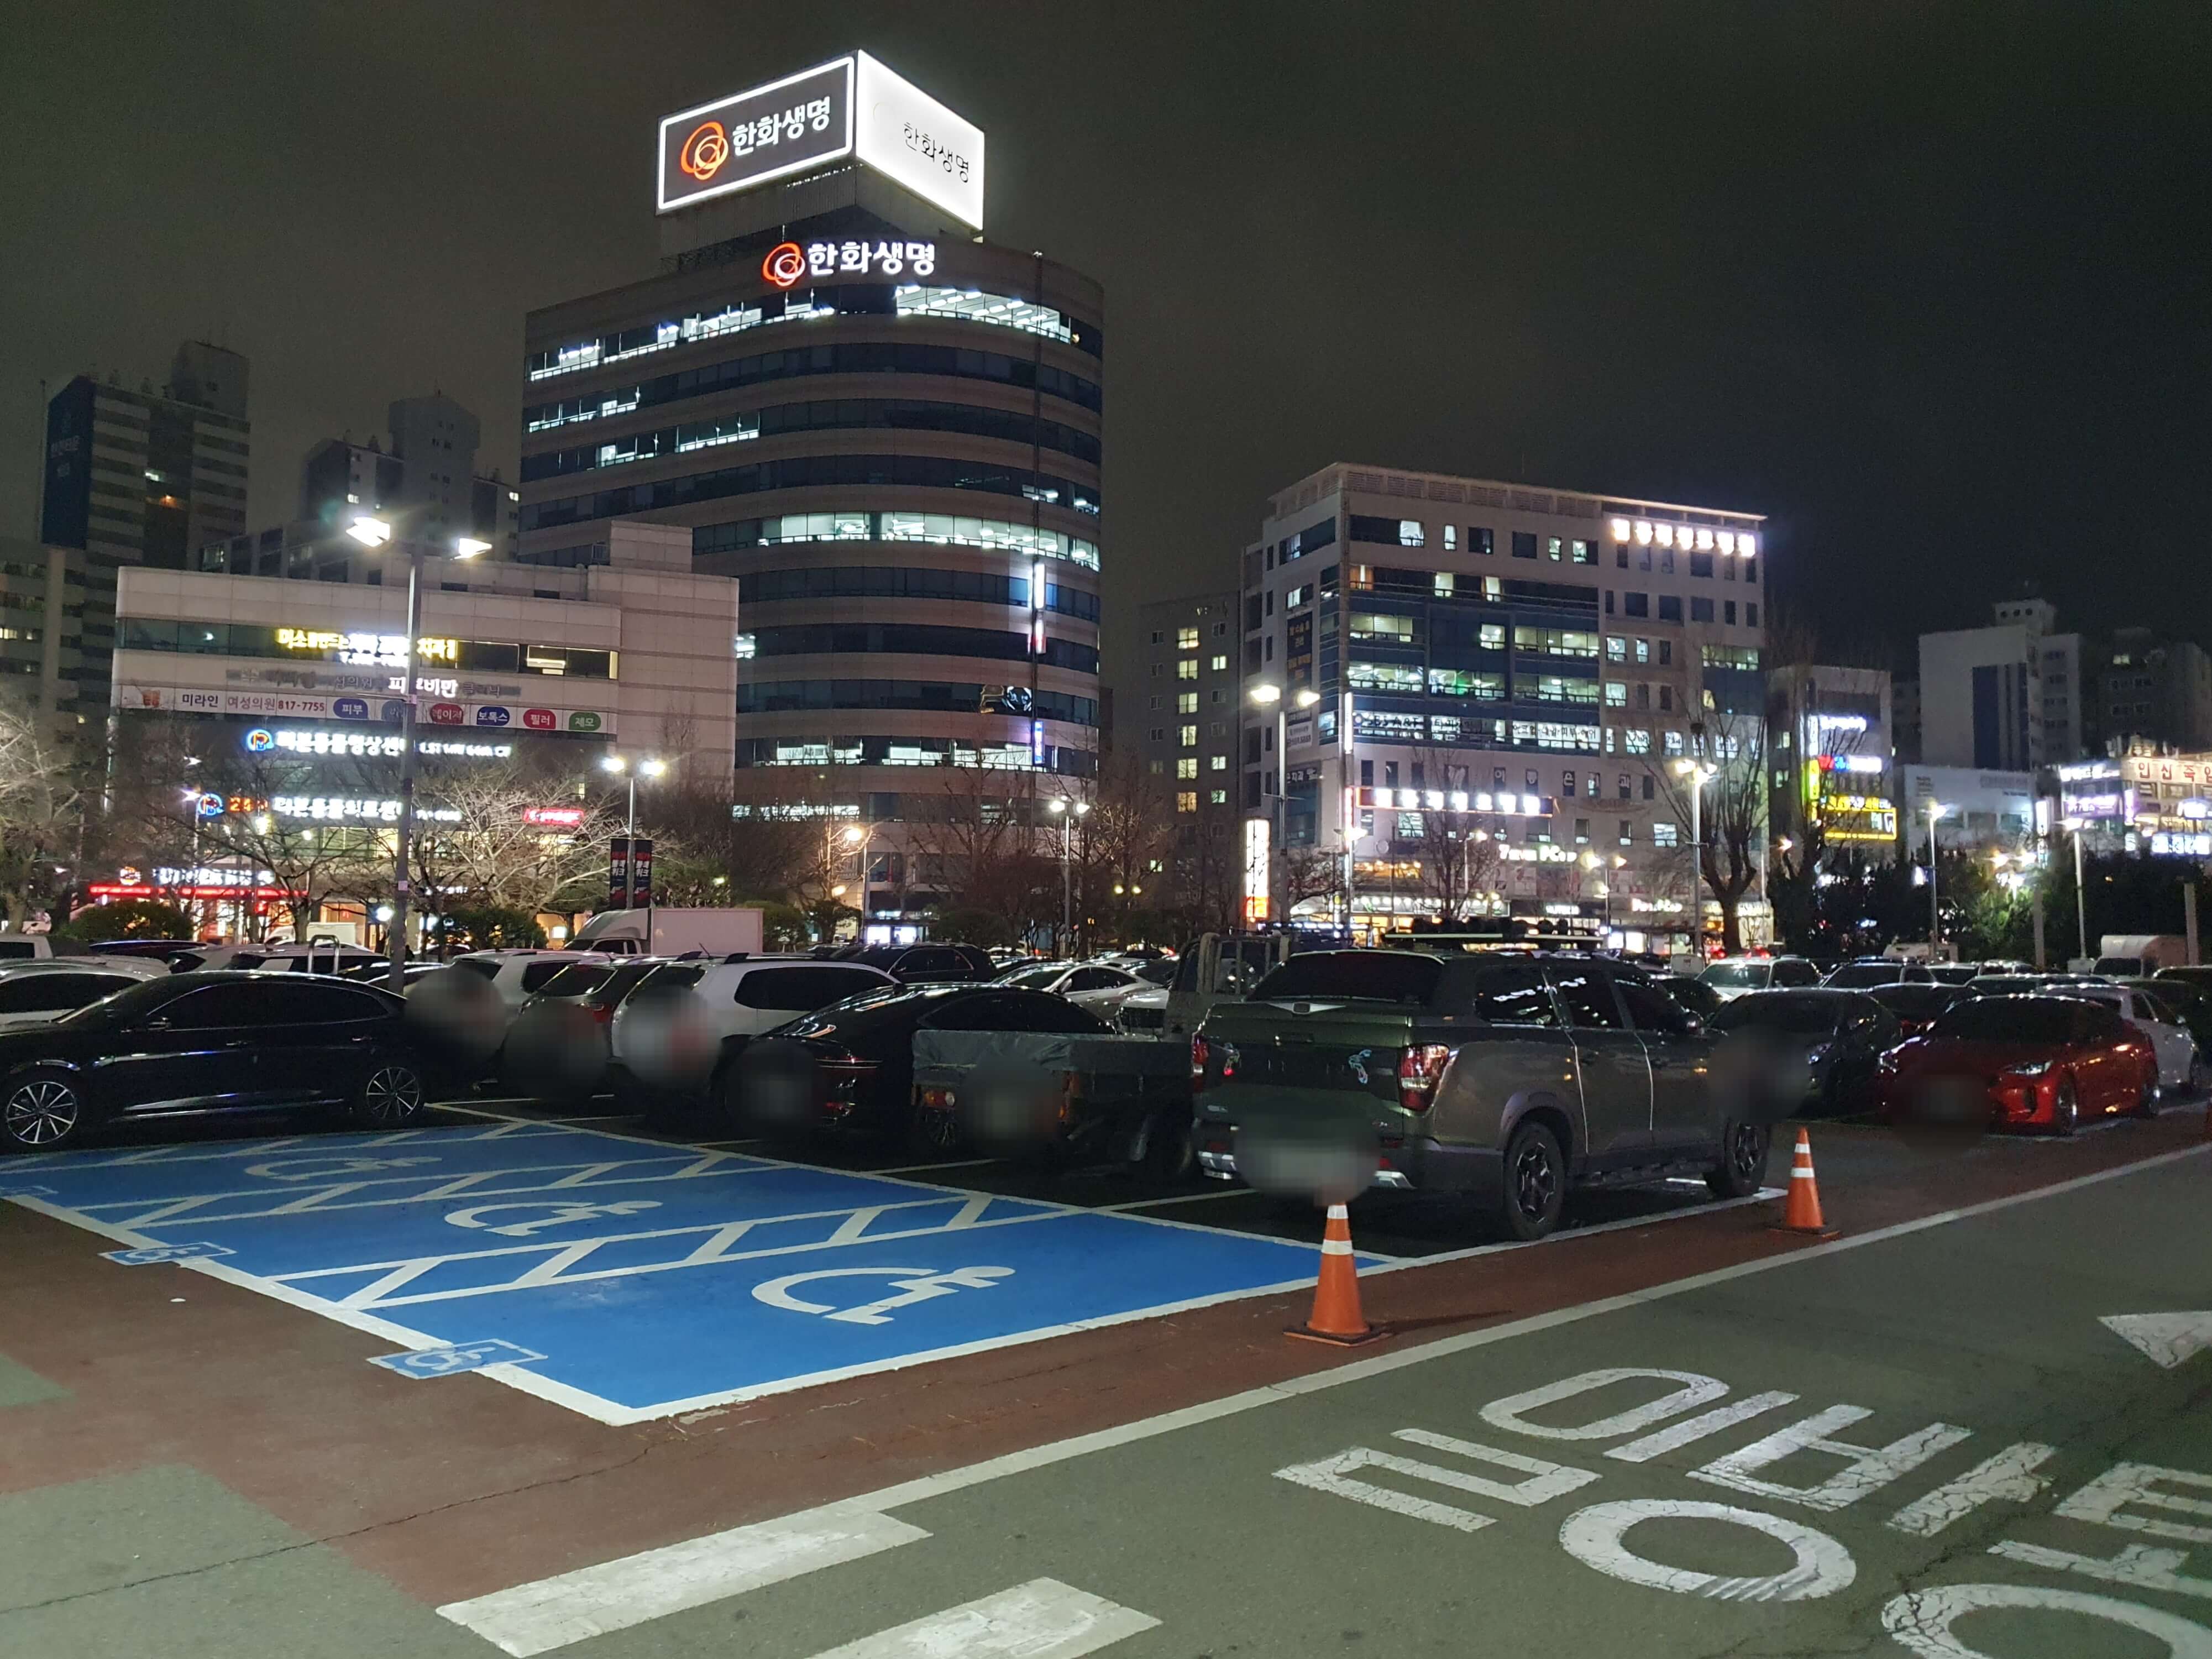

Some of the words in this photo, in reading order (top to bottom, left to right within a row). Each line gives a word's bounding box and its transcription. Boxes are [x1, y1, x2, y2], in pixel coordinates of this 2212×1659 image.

[732, 95, 831, 157] 한화생명
[903, 121, 970, 184] 한화생명
[807, 240, 936, 276] 한화생명
[181, 693, 219, 709] 미라인
[227, 694, 276, 711] 여성의원
[277, 700, 326, 713] 817-7755
[341, 703, 364, 716] 피부
[477, 711, 509, 723] 보톡스
[530, 713, 551, 727] 필러
[574, 716, 595, 729] 제모
